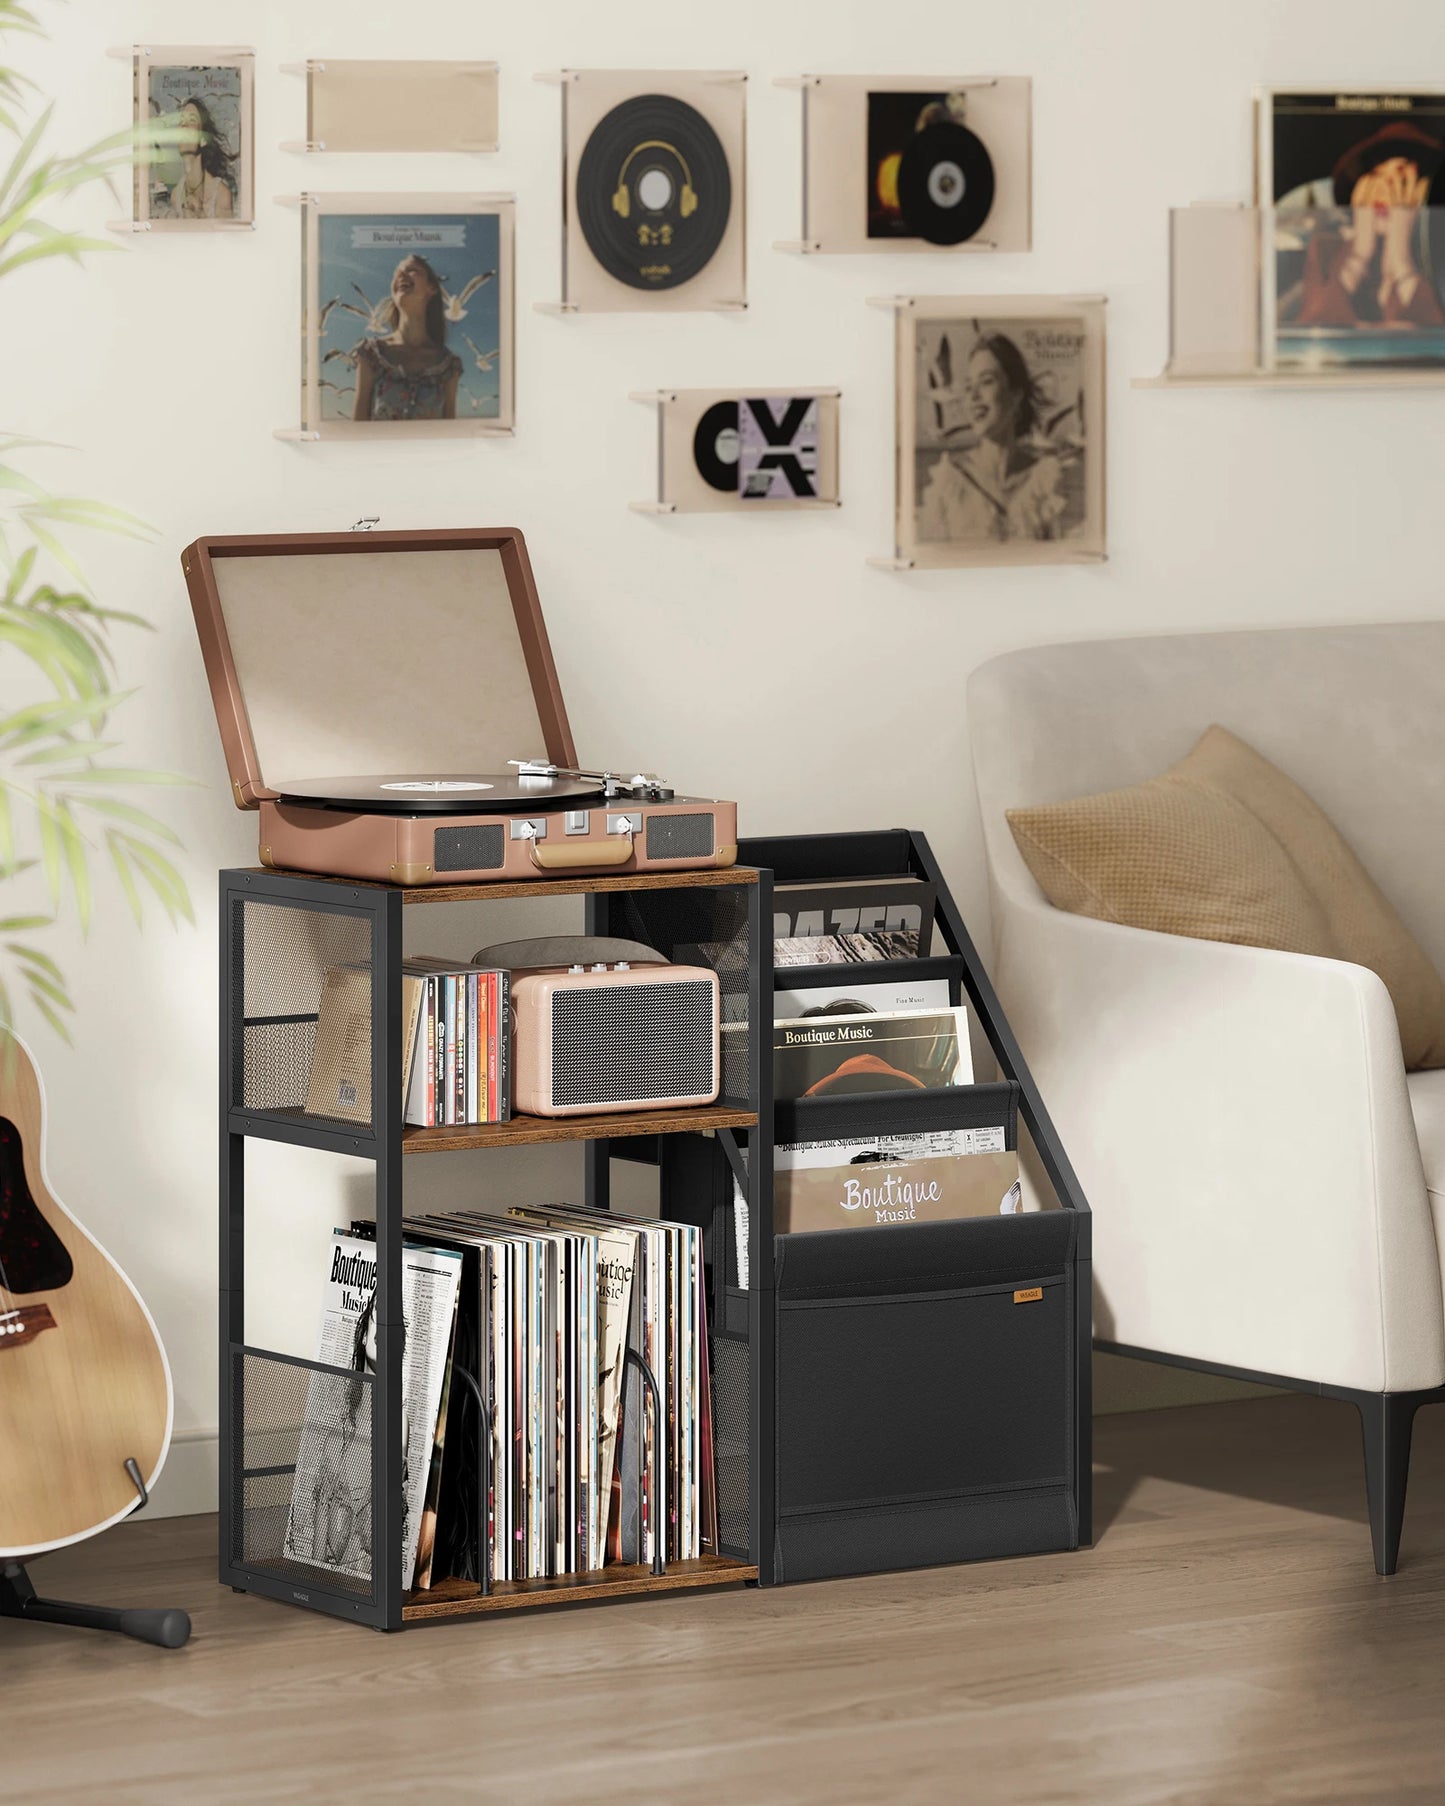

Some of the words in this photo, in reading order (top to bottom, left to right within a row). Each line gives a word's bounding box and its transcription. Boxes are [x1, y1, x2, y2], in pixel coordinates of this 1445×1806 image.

[785, 1028, 836, 1045] Boutique
[837, 1026, 874, 1041] Music
[840, 1173, 943, 1210] Boutique
[874, 1206, 917, 1223] Music
[330, 1245, 377, 1296] Boutique
